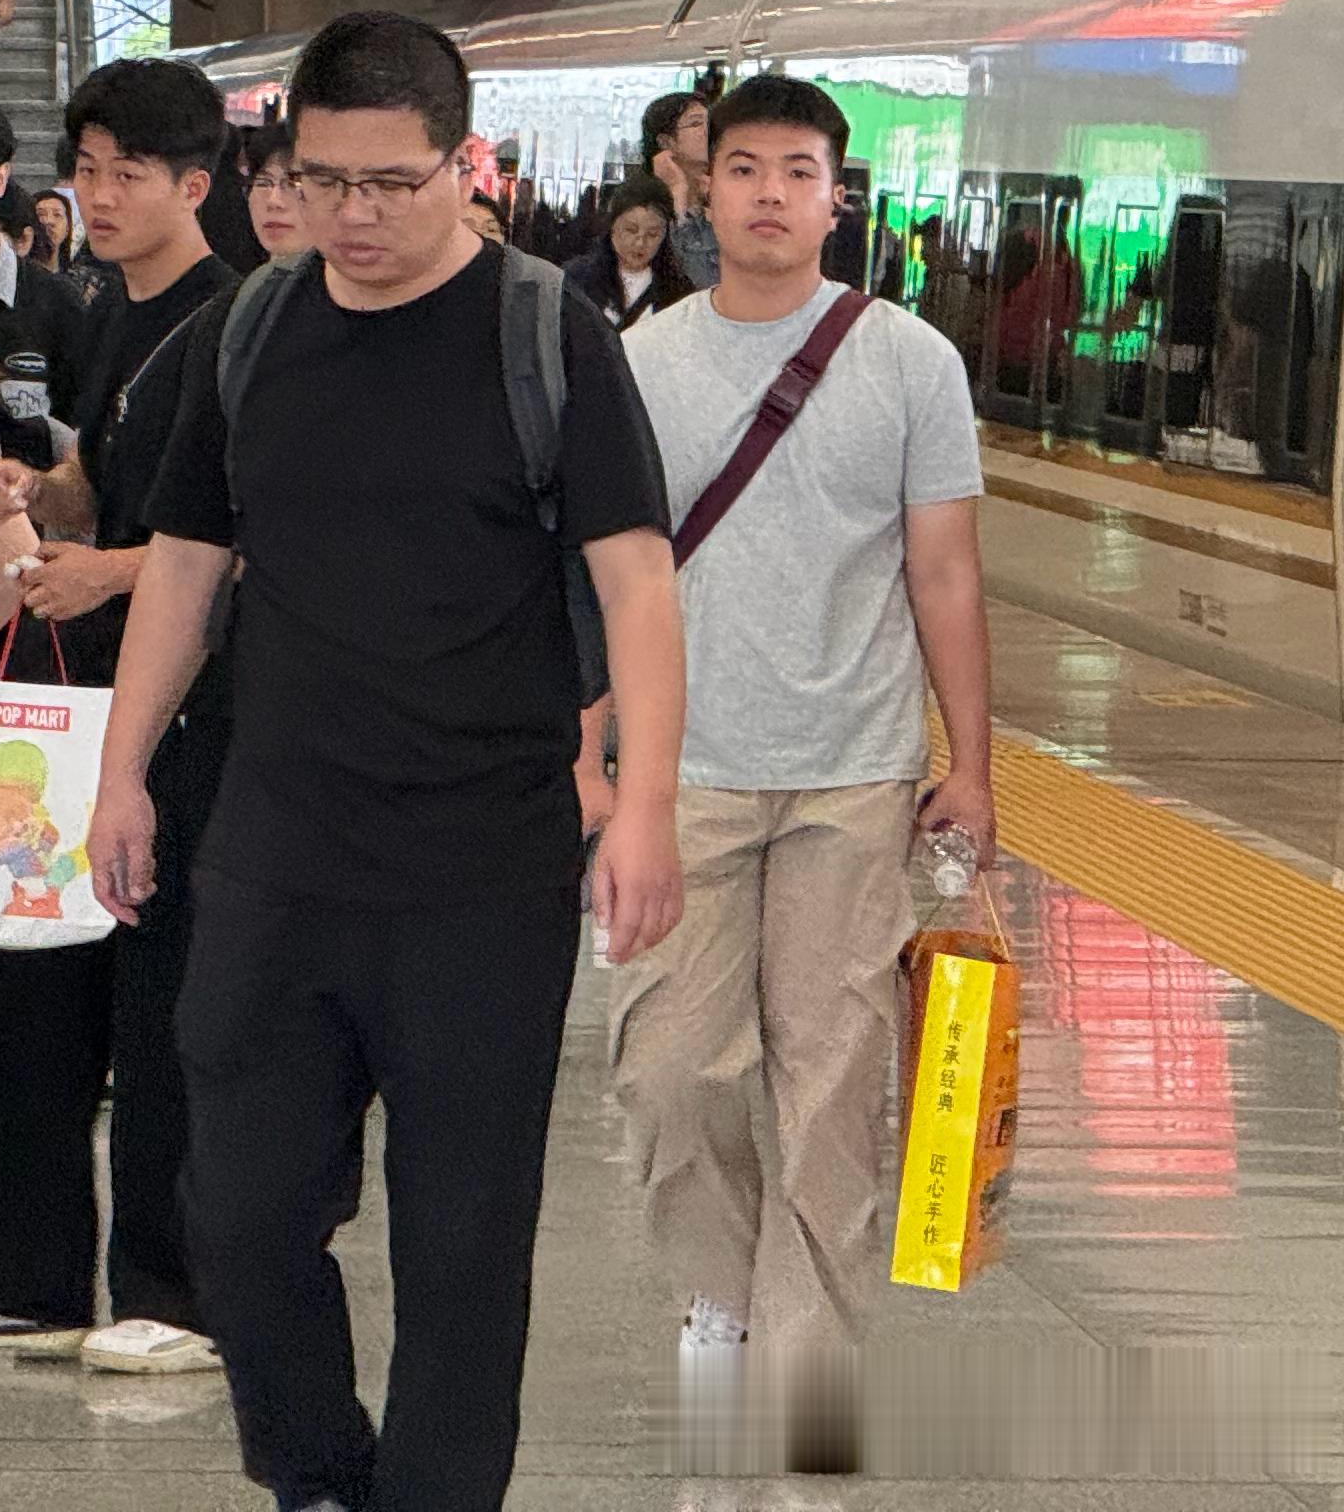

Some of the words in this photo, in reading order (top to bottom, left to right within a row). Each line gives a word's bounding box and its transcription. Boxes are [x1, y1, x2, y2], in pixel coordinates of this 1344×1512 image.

[24, 707, 68, 729] MART
[936, 1020, 964, 1113] 传承经典
